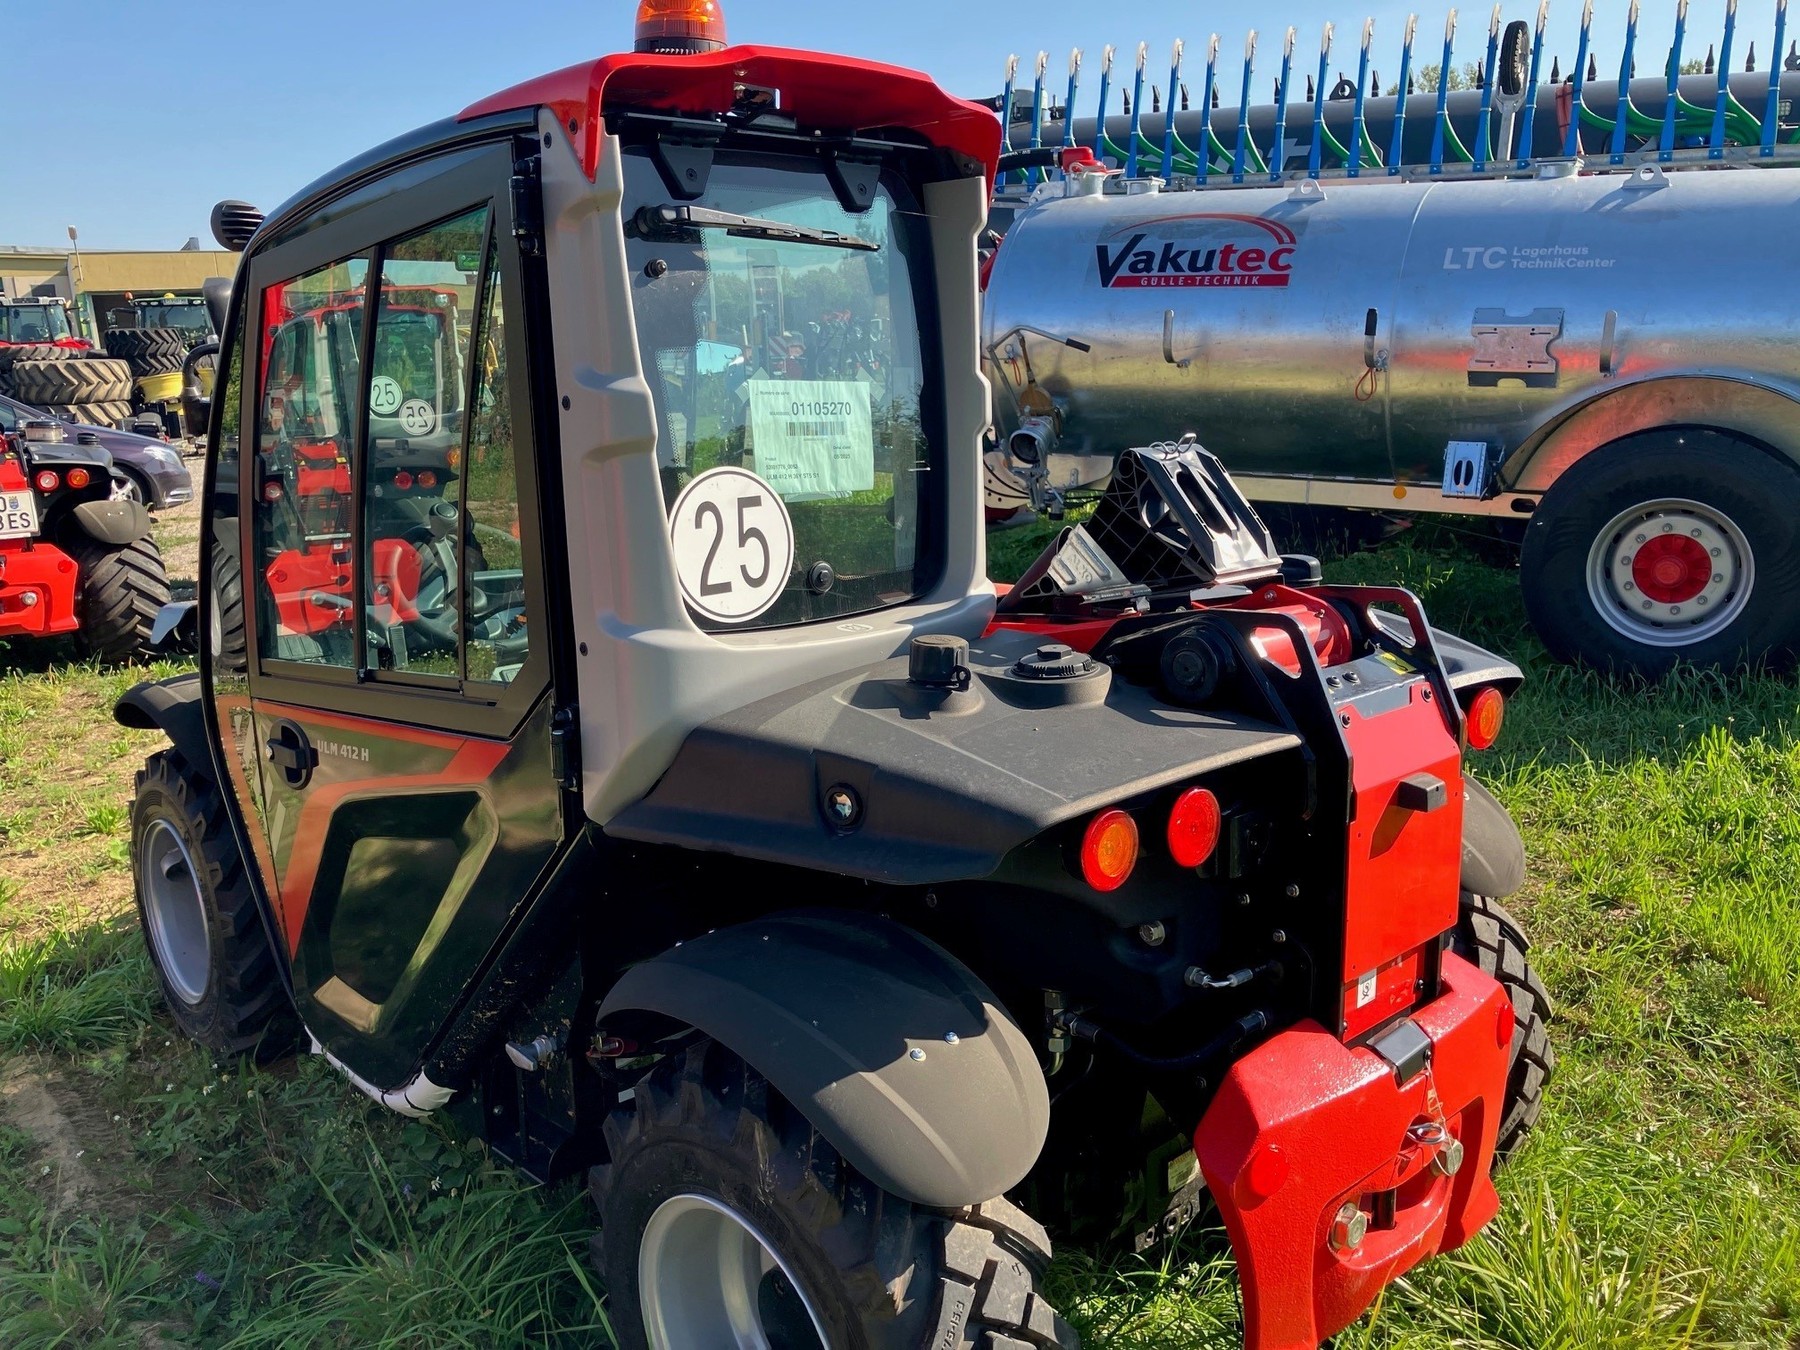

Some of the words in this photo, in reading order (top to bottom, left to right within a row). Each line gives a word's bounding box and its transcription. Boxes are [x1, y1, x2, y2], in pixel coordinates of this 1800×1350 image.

[1095, 233, 1297, 288] Vakutec
[1442, 246, 1508, 270] LTC
[1512, 245, 1589, 257] Lagerhaus
[1511, 257, 1616, 269] TechnikCenter
[372, 383, 396, 407] 25
[791, 402, 852, 416] 01105270
[694, 495, 770, 597] 25
[317, 739, 338, 756] ULM
[340, 744, 359, 760] 412
[361, 748, 369, 762] H
